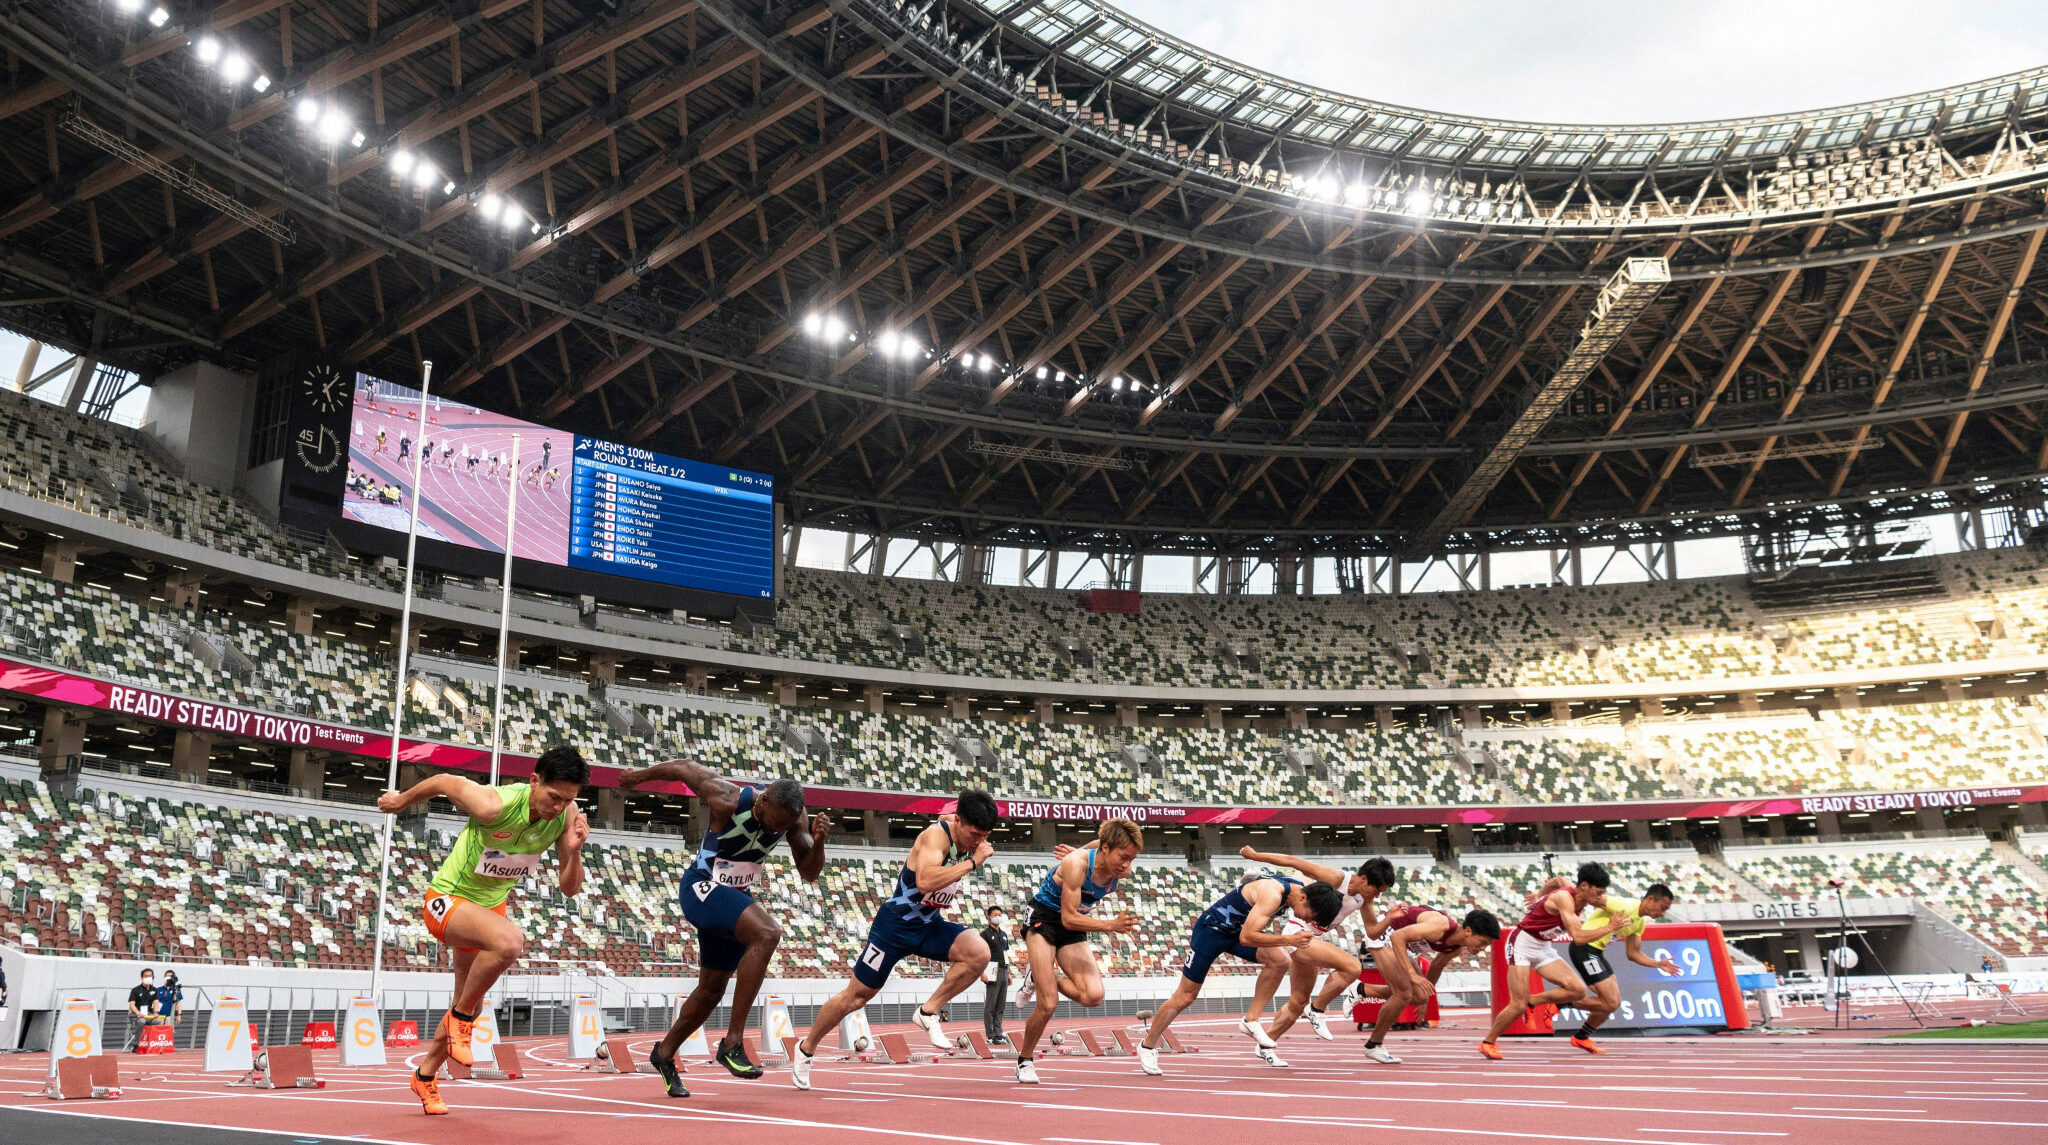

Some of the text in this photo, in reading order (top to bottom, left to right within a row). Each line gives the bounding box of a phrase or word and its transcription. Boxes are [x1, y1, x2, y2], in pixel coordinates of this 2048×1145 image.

[299, 429, 313, 441] 45
[594, 440, 654, 461] MEN'S 100M
[577, 458, 608, 470] START LIST
[594, 450, 628, 466] ROUND
[630, 459, 635, 468] 1
[644, 461, 668, 475] HEAT
[670, 468, 686, 478] 1/2
[595, 481, 606, 489] JPN
[618, 486, 640, 496] SASAKI
[619, 476, 645, 488] KUSANO
[594, 491, 606, 499] JPN
[617, 506, 641, 516] HONDA
[593, 520, 604, 528] JPN
[617, 525, 635, 534] ENDO
[617, 515, 634, 524] TADA
[593, 530, 604, 538] JPN
[616, 535, 635, 545] KOIKE
[616, 545, 639, 555] GATLIN
[616, 555, 640, 565] YASUDA
[110, 686, 364, 744] READY STEADY TOKYO Test Events
[1802, 788, 2022, 812] READY STEADY TOKYO Test Events
[1008, 802, 1186, 821] READY STEADY TOKYO Test Events
[483, 862, 529, 876] YASUDA
[719, 873, 754, 885] GATLIN
[699, 881, 712, 894] 8
[432, 897, 446, 916] 9
[1753, 902, 1818, 918] GATE 5
[868, 946, 881, 965] 7
[1589, 962, 1597, 973] 1
[1641, 989, 1722, 1019] 100m
[353, 1017, 377, 1047] 6
[473, 1016, 493, 1044] 5
[581, 1015, 599, 1041] 4
[65, 1022, 92, 1056] 8
[218, 1020, 242, 1052] 7
